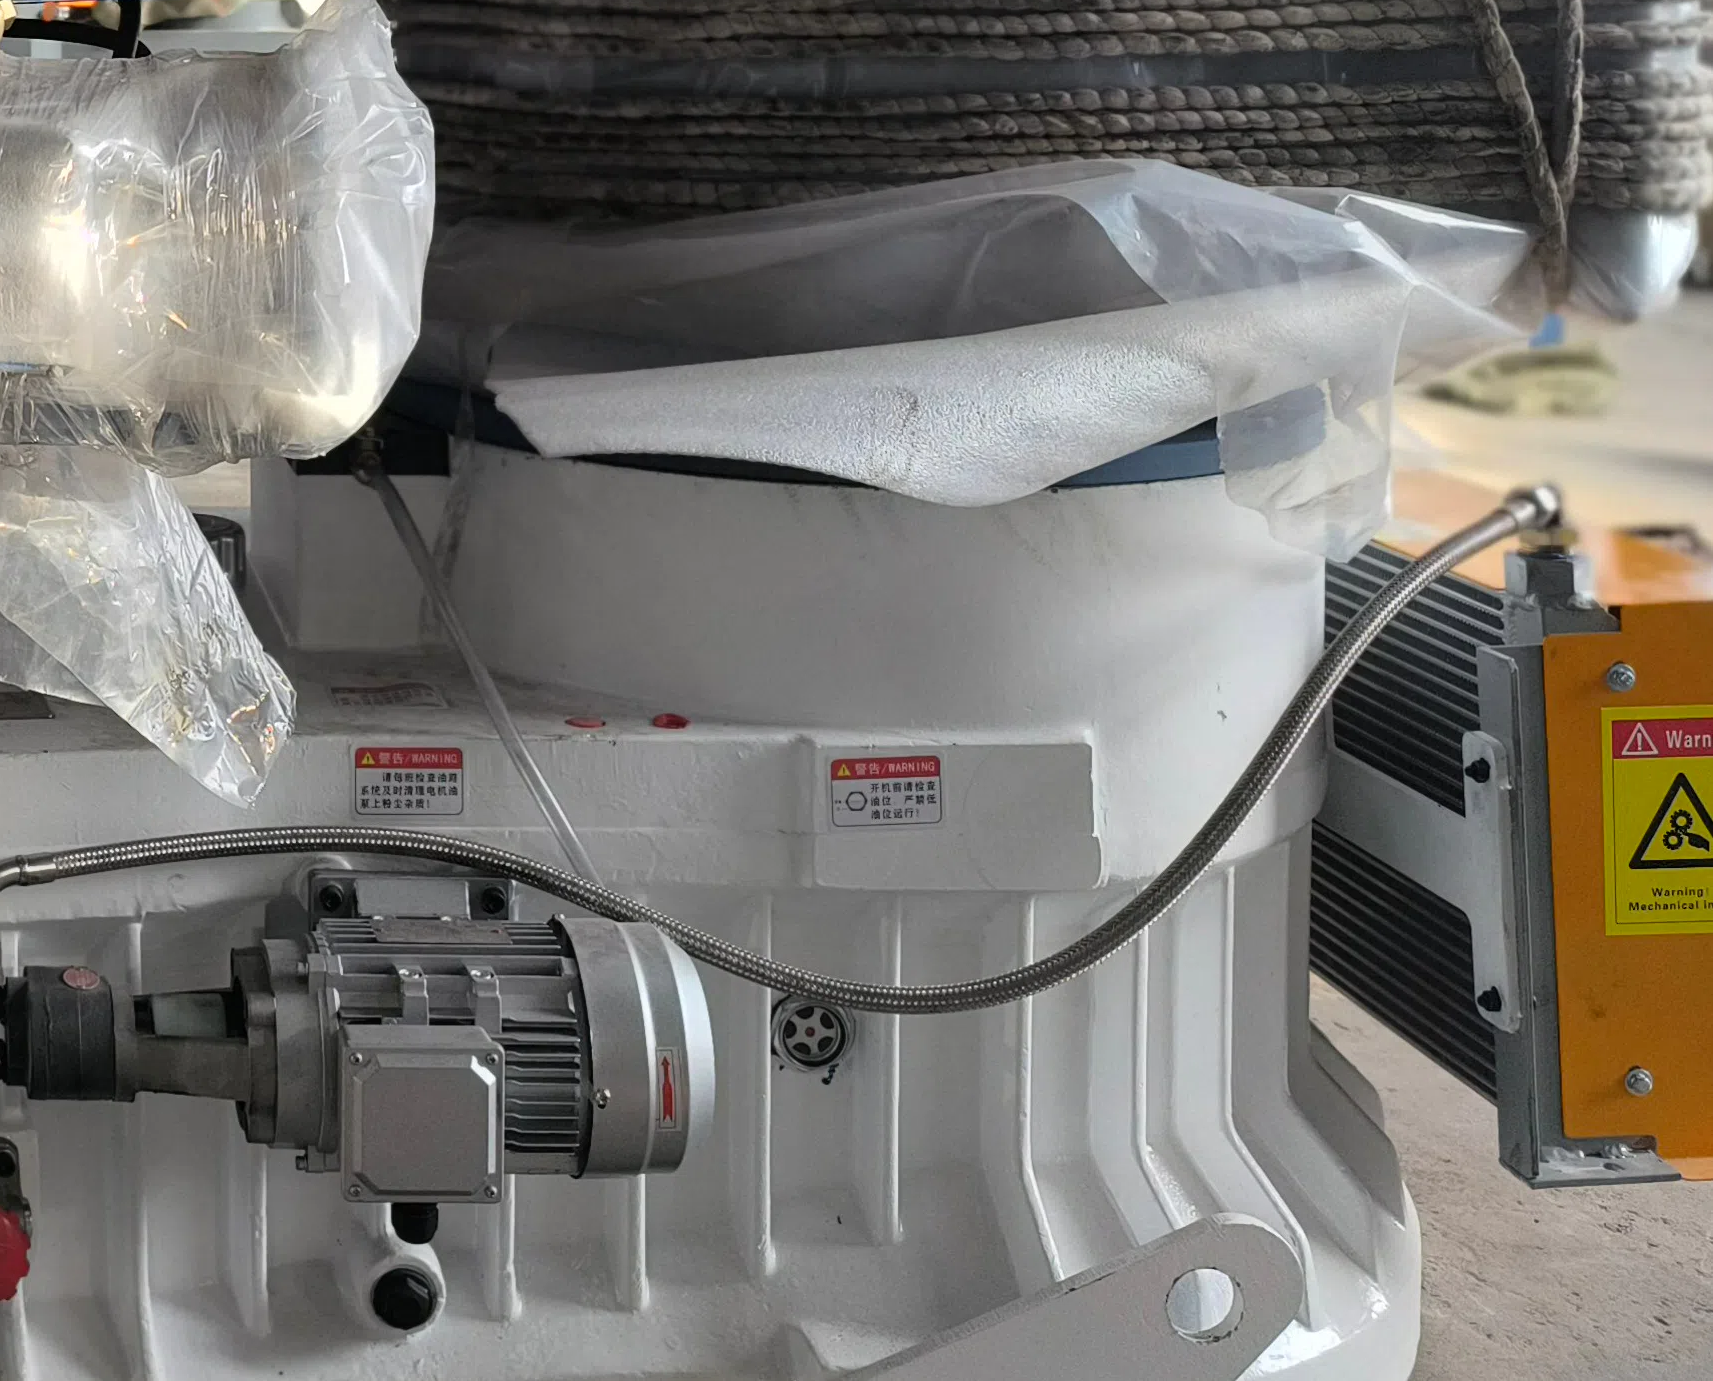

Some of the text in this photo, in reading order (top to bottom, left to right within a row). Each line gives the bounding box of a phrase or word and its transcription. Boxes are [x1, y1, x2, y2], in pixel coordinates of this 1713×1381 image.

[1665, 730, 1713, 749] Warn
[378, 752, 458, 765] 警告/WARNING
[854, 761, 935, 775] 警告/WARNING
[870, 781, 936, 794] 开机前请检查
[1628, 900, 1700, 912] Mechanical
